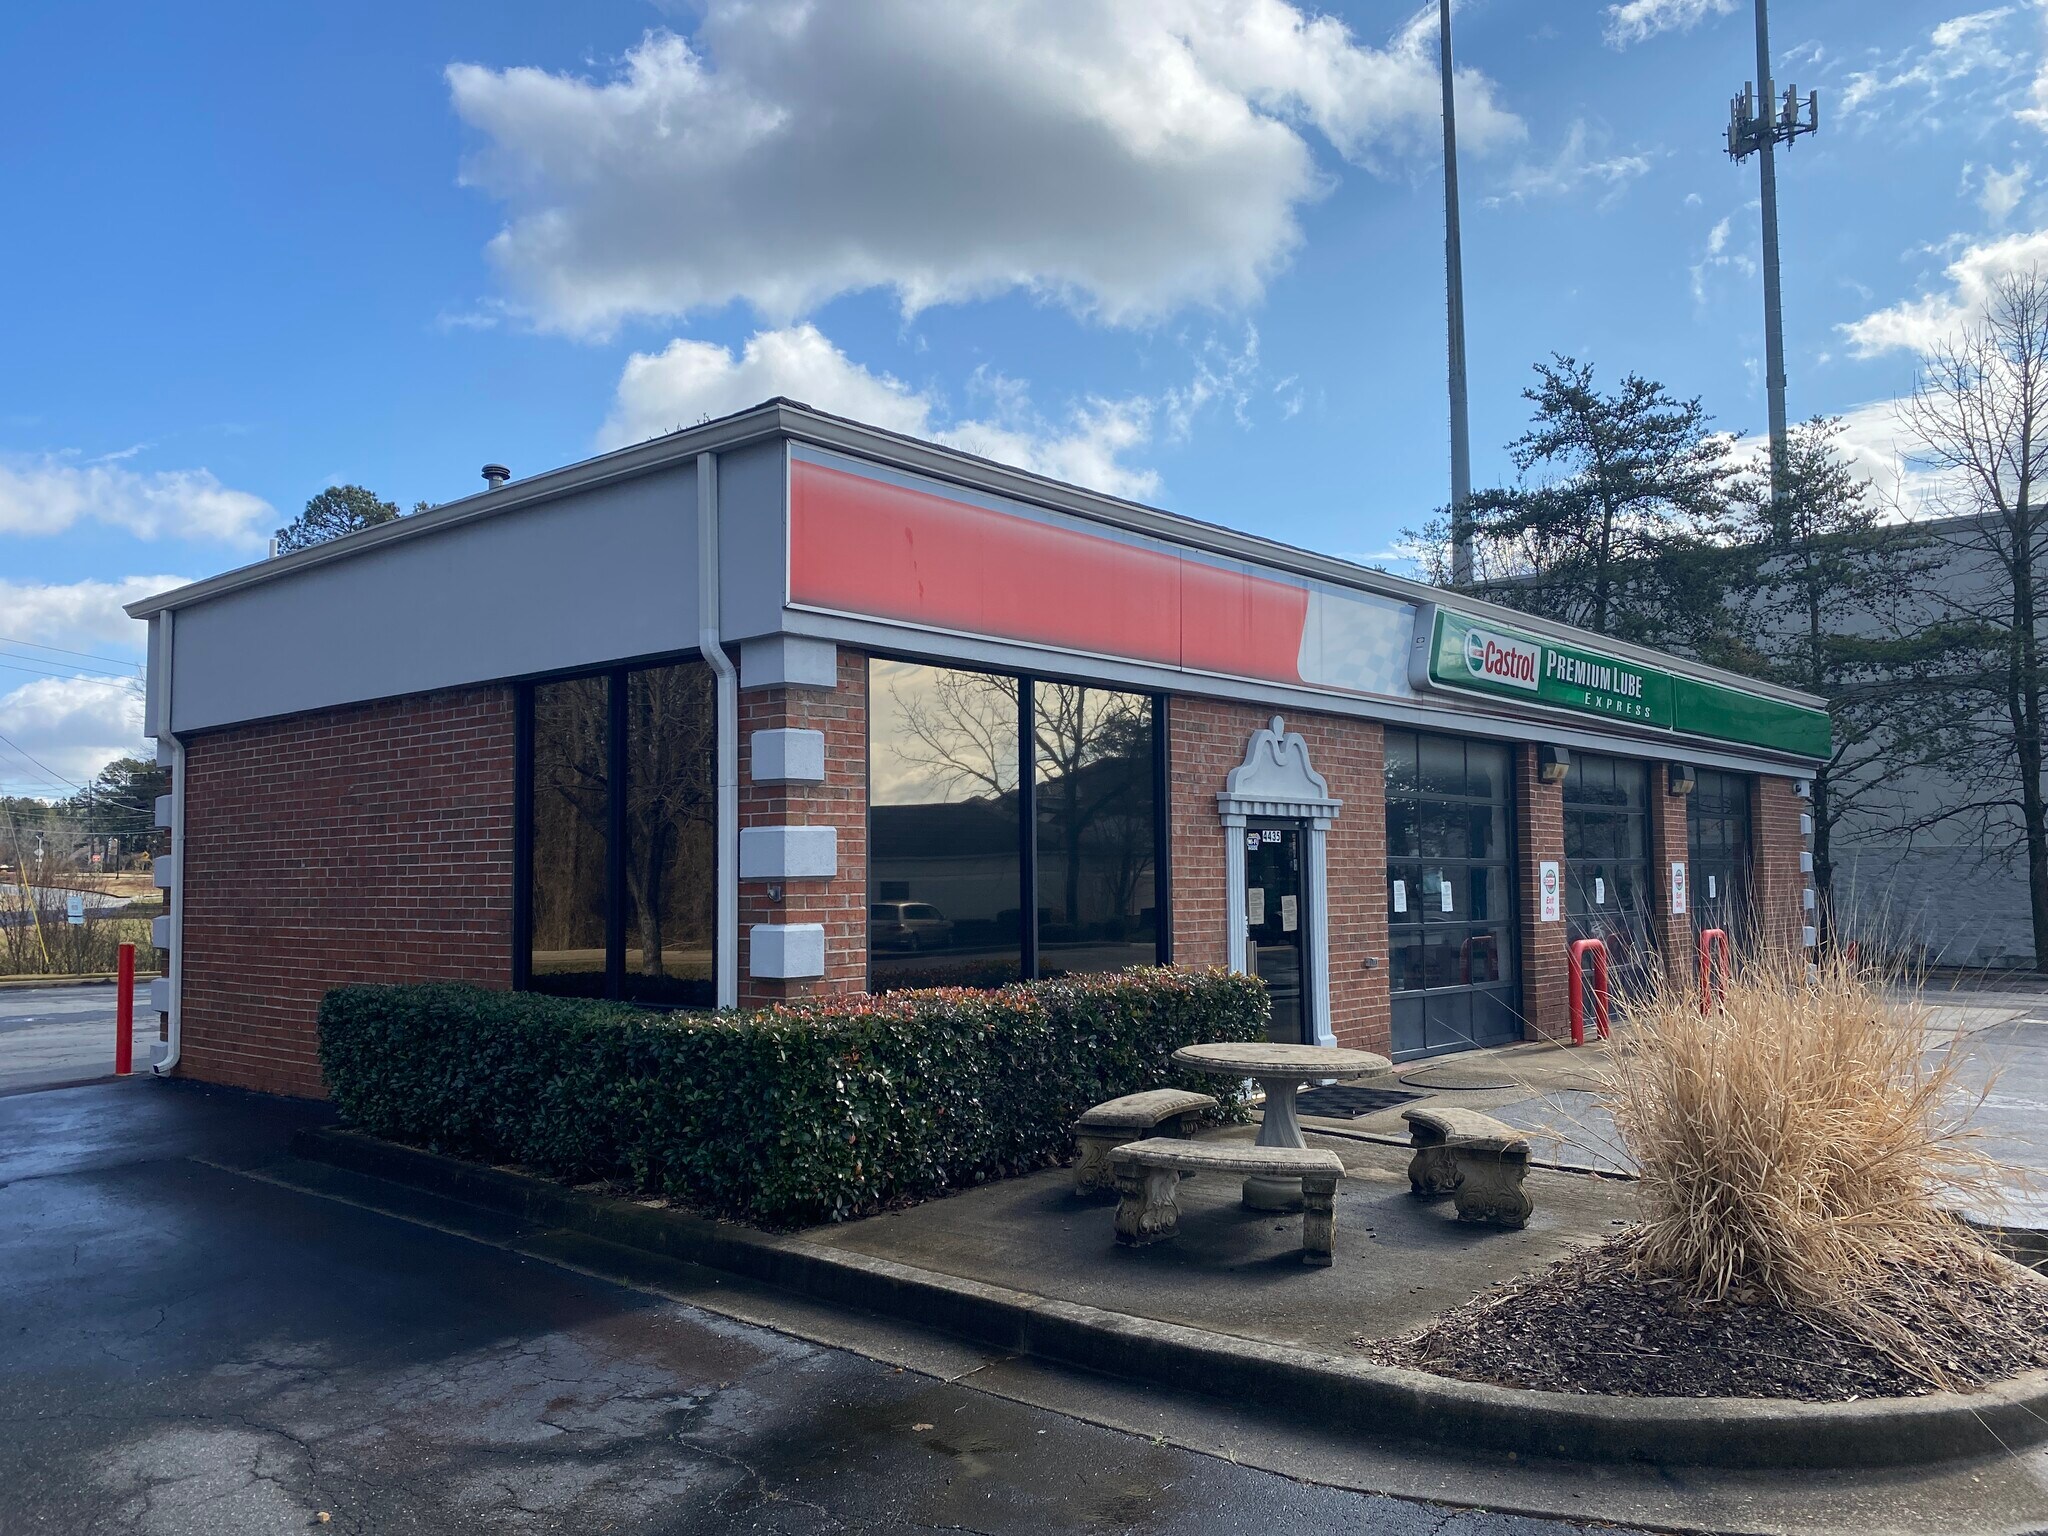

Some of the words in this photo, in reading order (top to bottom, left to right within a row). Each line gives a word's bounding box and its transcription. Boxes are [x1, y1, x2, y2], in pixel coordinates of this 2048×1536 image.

[1485, 640, 1535, 682] Castrol
[1546, 649, 1611, 691] PREMIUM
[1613, 666, 1643, 698] LUBE
[1584, 691, 1651, 718] EXPRESS
[1263, 831, 1281, 842] 4435
